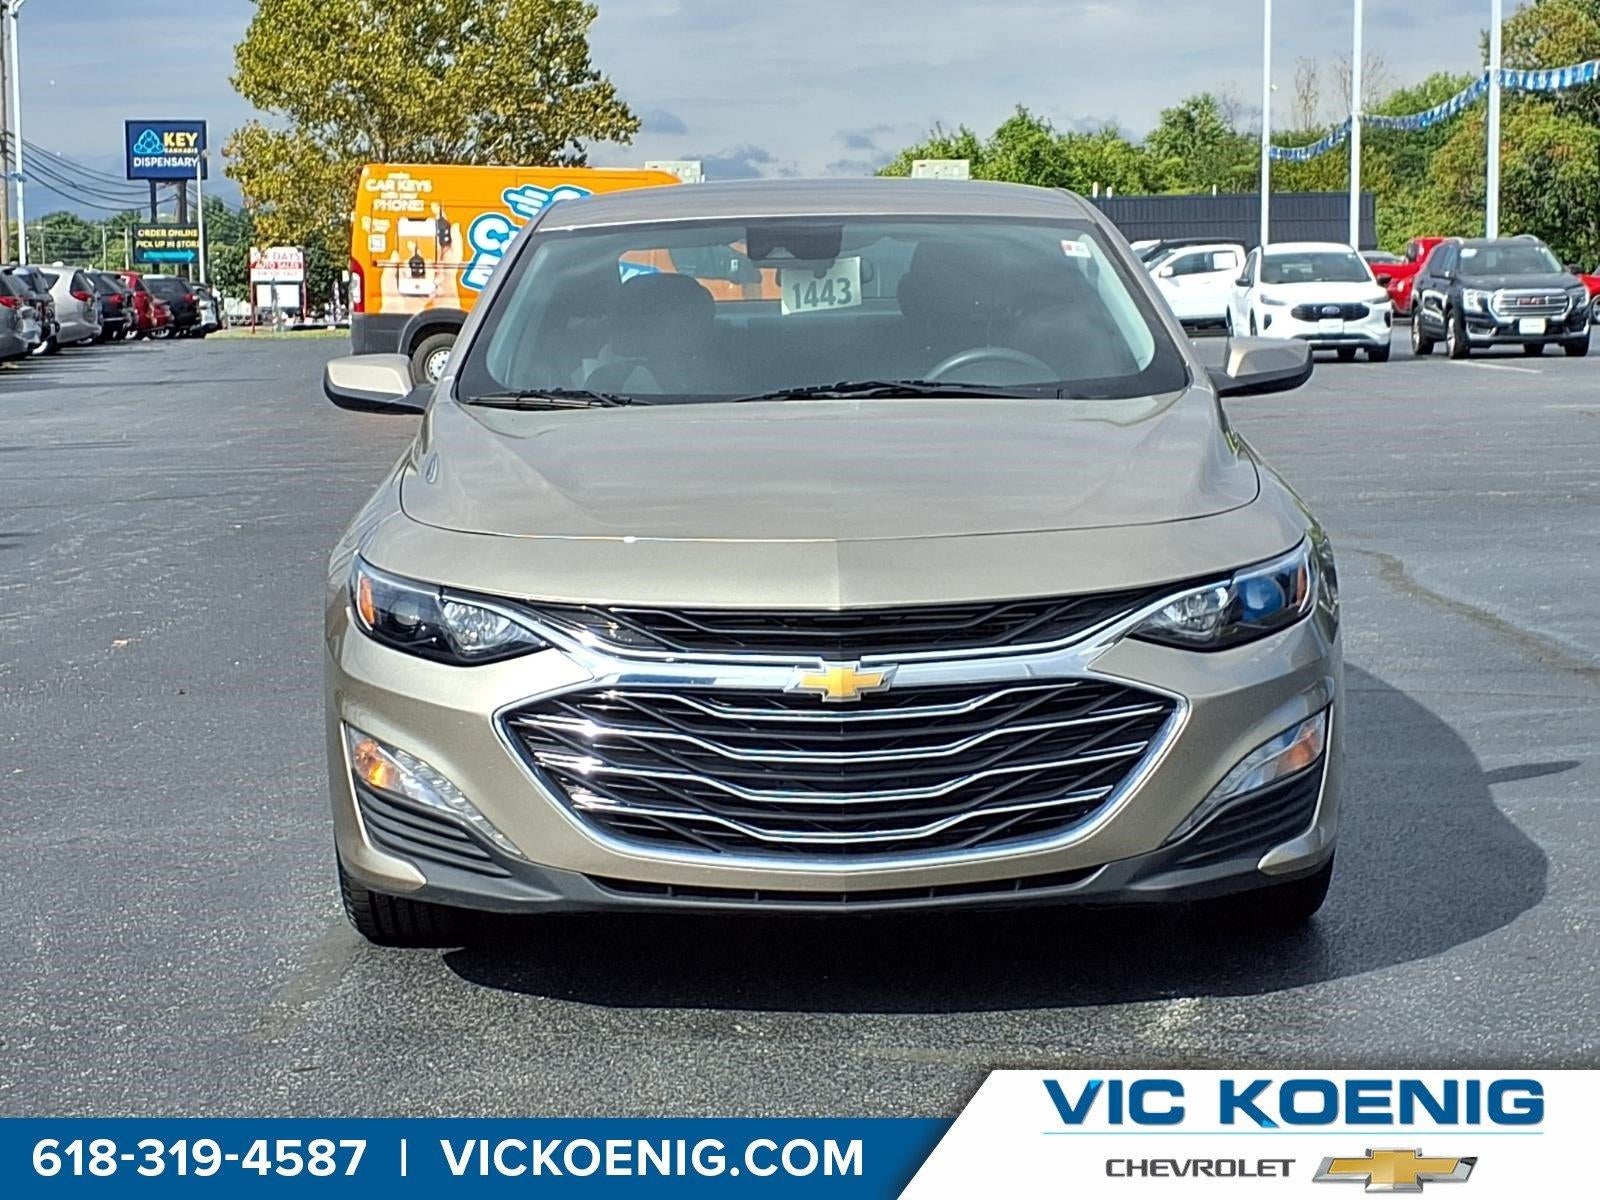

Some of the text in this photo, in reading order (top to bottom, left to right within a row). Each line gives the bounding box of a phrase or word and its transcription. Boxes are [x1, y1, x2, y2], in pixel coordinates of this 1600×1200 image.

[163, 132, 198, 147] KEY
[133, 156, 199, 168] DISPENSARY
[365, 179, 432, 192] CAR KEYS
[137, 229, 198, 237] ORDER ONLINE
[136, 240, 154, 248] PICK
[154, 240, 166, 248] UP
[792, 277, 852, 310] 1443
